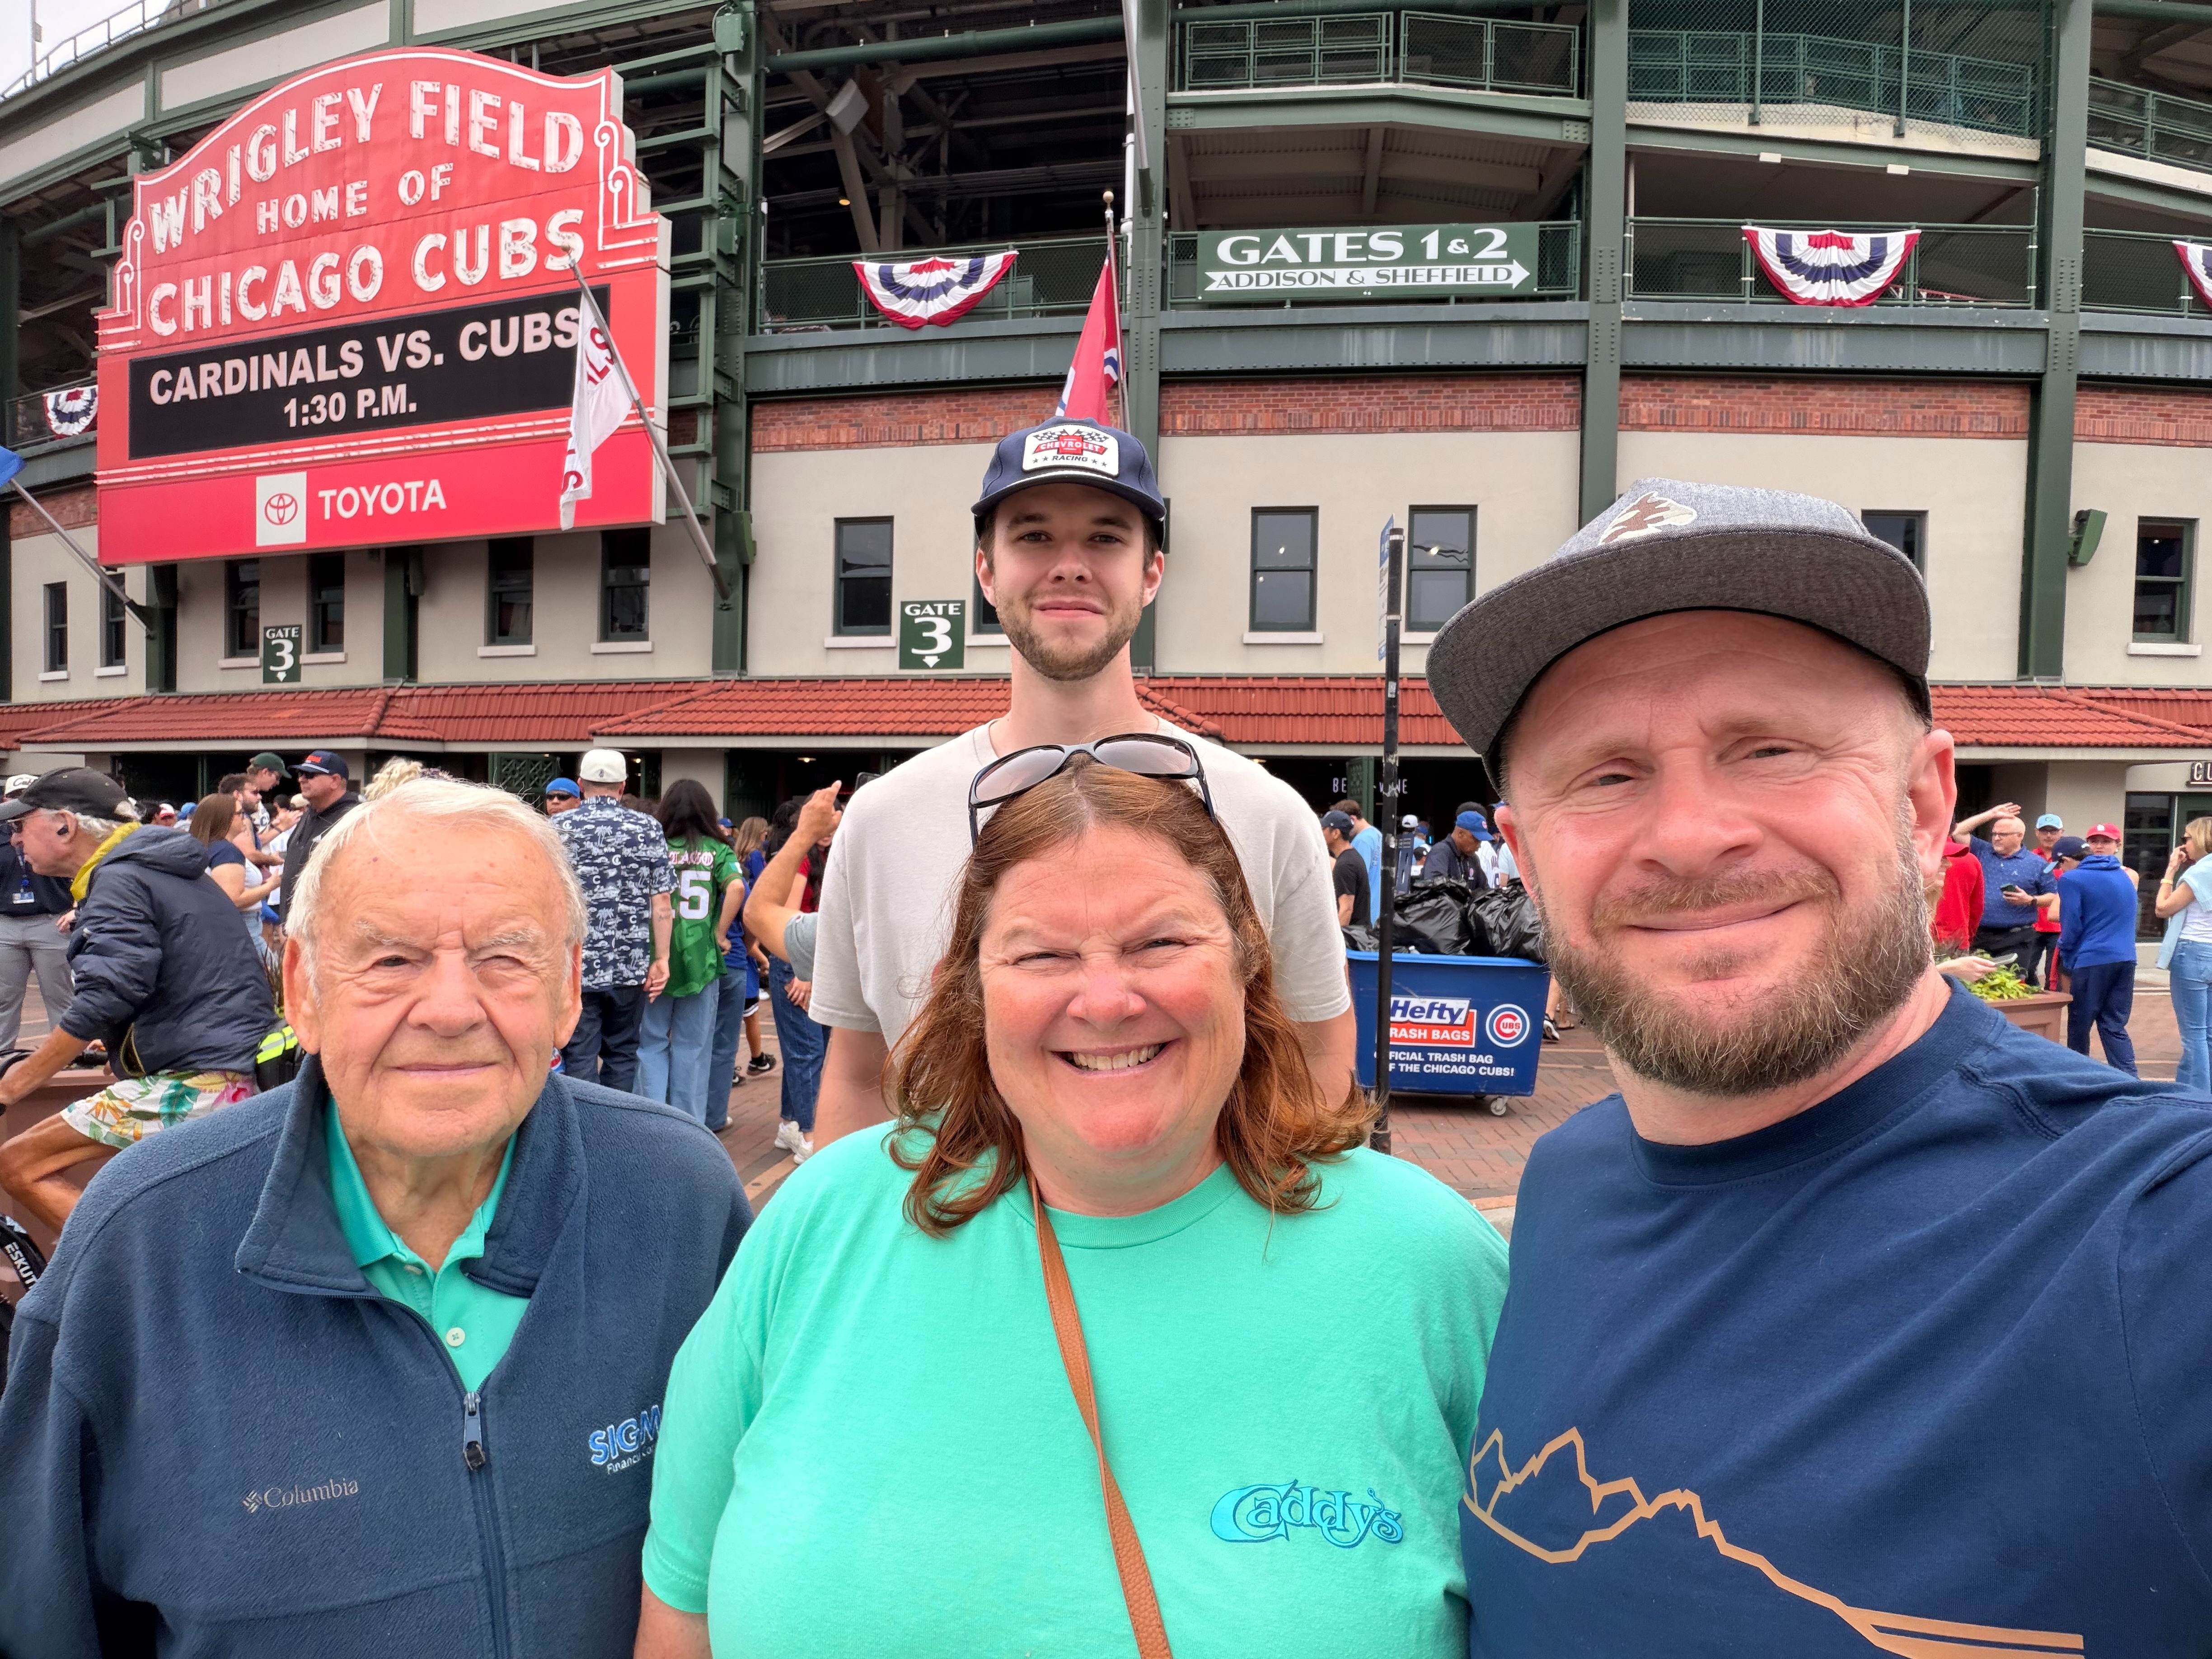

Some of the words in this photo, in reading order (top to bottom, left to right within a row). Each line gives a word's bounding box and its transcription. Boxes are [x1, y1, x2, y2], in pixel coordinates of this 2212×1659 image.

[148, 83, 383, 254] WRIGLEY
[410, 80, 584, 173] FIELD
[257, 181, 368, 235] HOME
[398, 163, 453, 206] OF
[1217, 231, 1404, 266] GATES
[1420, 229, 1439, 260] 1
[1447, 239, 1470, 254] &
[1472, 228, 1508, 259] 2
[147, 244, 383, 337] CHICAGO
[411, 209, 584, 292] CUBS
[1216, 271, 1336, 289] ADDISON
[1346, 269, 1366, 285] &
[1375, 266, 1513, 285] SHEFFIELD
[150, 340, 364, 406] CARDINALS
[377, 330, 445, 372] VS.
[459, 308, 580, 361] CUBS
[284, 392, 347, 428] 1:30
[356, 383, 418, 420] P.M.
[1040, 441, 1101, 452] CHEVROLET
[318, 479, 447, 520] TOYOTA
[904, 603, 961, 616] GATE
[266, 627, 300, 639] GATE
[911, 617, 952, 654] 3
[270, 639, 294, 671] 3
[672, 870, 711, 919] 5
[1390, 1000, 1465, 1024] Hefty
[1495, 1014, 1520, 1037] CUBS
[1390, 1028, 1427, 1039] RASH
[1431, 1030, 1470, 1041] BAGS
[1389, 1051, 1425, 1062] FICIAL
[1427, 1053, 1466, 1063] TRASH
[1469, 1054, 1494, 1064] BAG
[1389, 1064, 1396, 1072] F
[1398, 1064, 1420, 1073] THE
[1423, 1064, 1475, 1075] CHICAGO
[1479, 1067, 1514, 1077] CUBS!
[4, 1242, 38, 1289] ESKUT
[264, 1478, 359, 1508] Columbia
[1210, 1479, 1403, 1549] Caddy's
